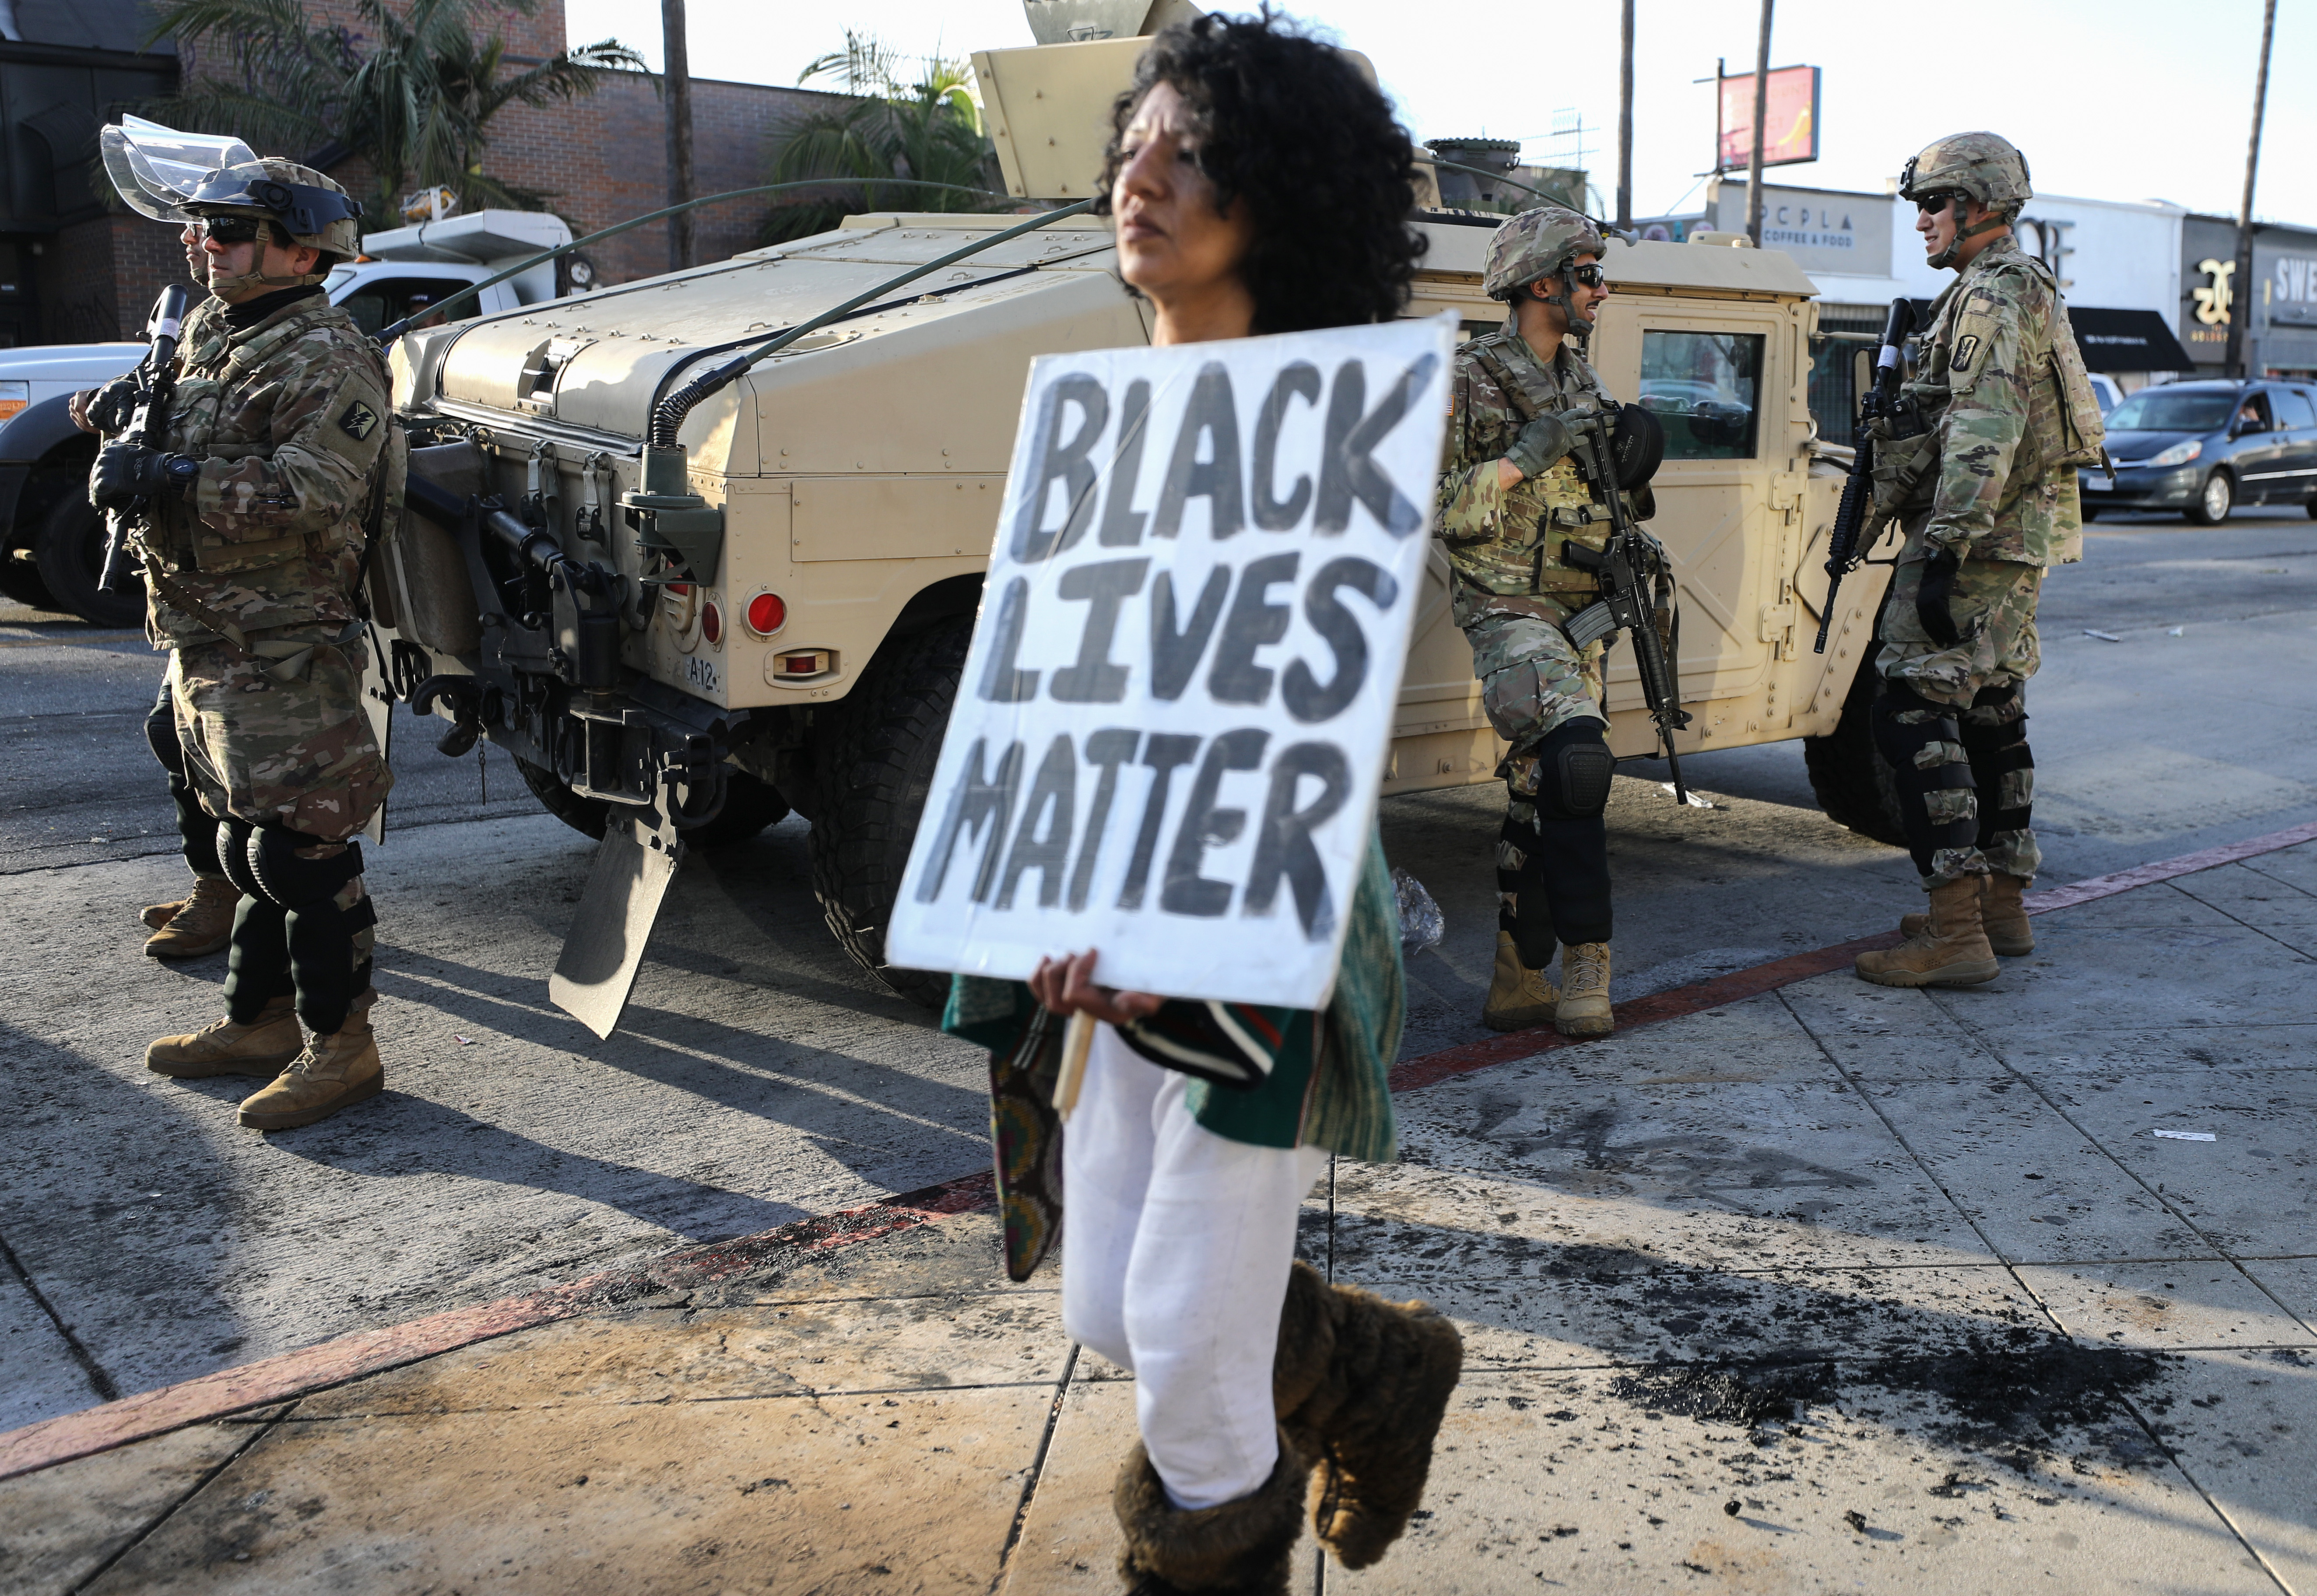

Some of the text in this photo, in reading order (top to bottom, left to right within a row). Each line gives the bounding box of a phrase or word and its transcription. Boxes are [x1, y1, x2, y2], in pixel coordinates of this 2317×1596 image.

[1764, 230, 1807, 244] COFFEE
[1822, 234, 1852, 247] FOOD
[1009, 352, 1439, 564] BLACK
[1622, 435, 1633, 463] REVISION
[690, 656, 713, 691] A12
[978, 551, 1399, 725] LIVES
[914, 727, 1353, 943] MATTER
